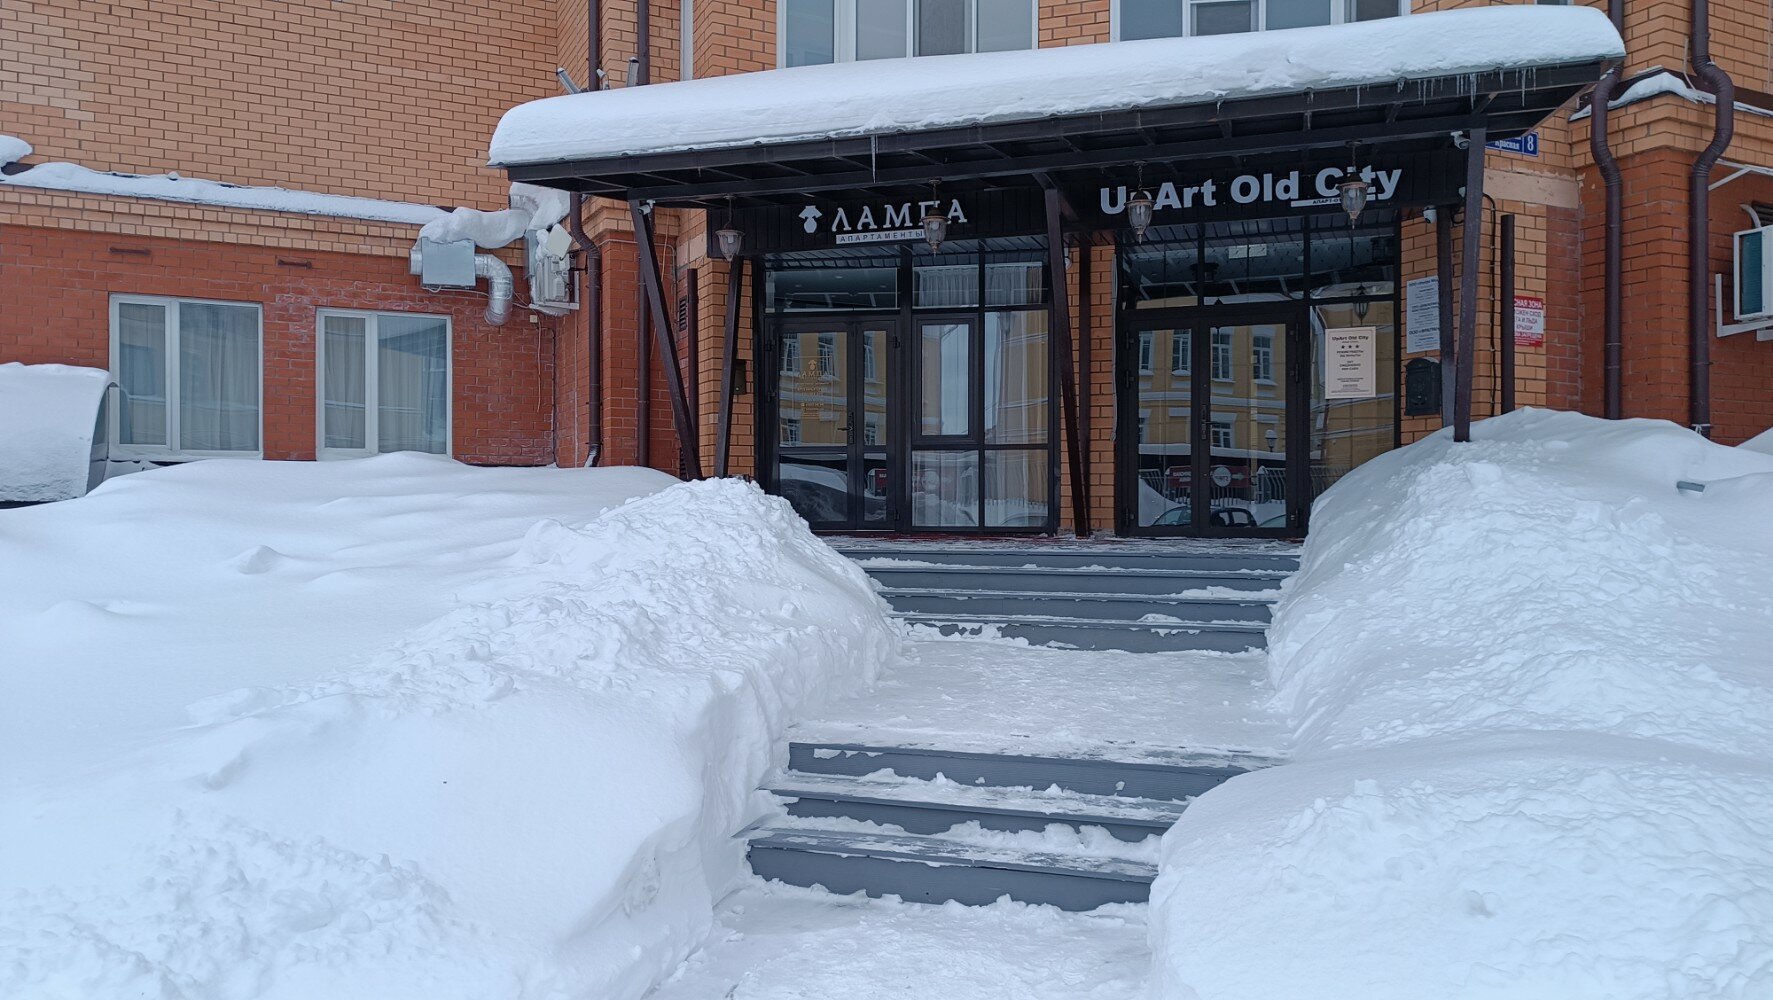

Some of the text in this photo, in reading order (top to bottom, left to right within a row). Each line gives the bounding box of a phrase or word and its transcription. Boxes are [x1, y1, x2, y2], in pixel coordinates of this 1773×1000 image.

[1527, 135, 1534, 151] 8
[1100, 164, 1402, 215] UArt Old Cty
[839, 230, 924, 243] АПАРТАМЕНТЫ
[1514, 298, 1542, 309] СНАЯ ЗОНА
